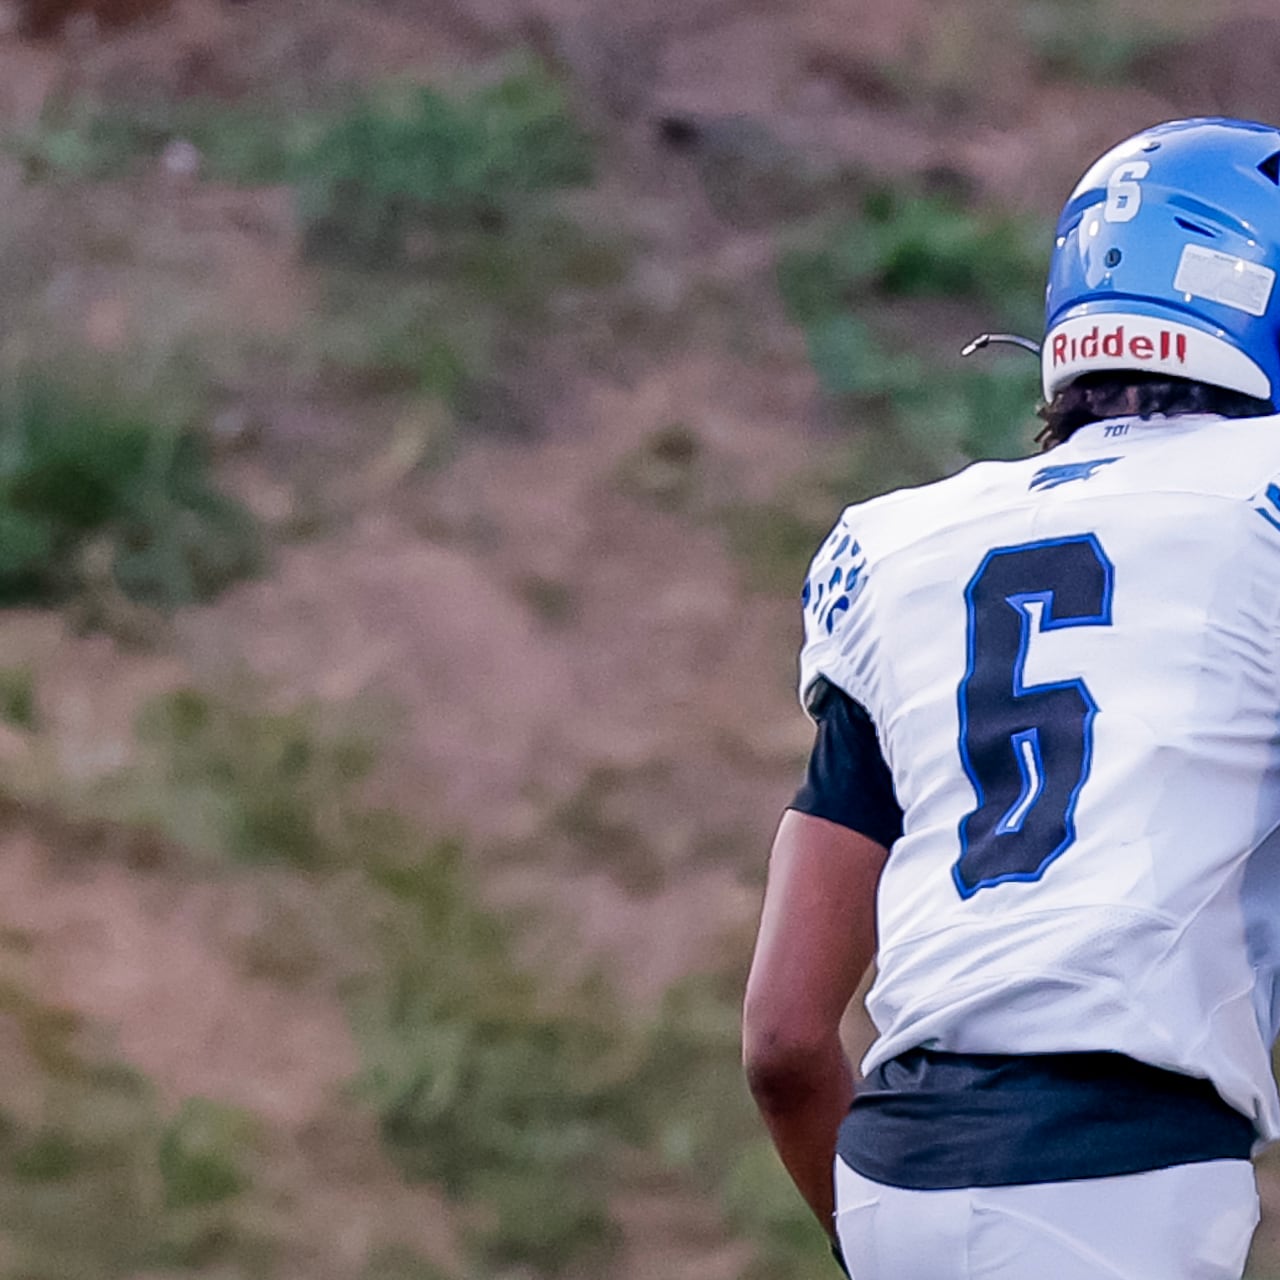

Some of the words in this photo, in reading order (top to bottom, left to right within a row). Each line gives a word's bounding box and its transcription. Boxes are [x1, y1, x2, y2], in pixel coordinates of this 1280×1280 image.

[1103, 160, 1151, 223] 6
[1053, 326, 1187, 368] Riddell
[950, 532, 1115, 903] 6
